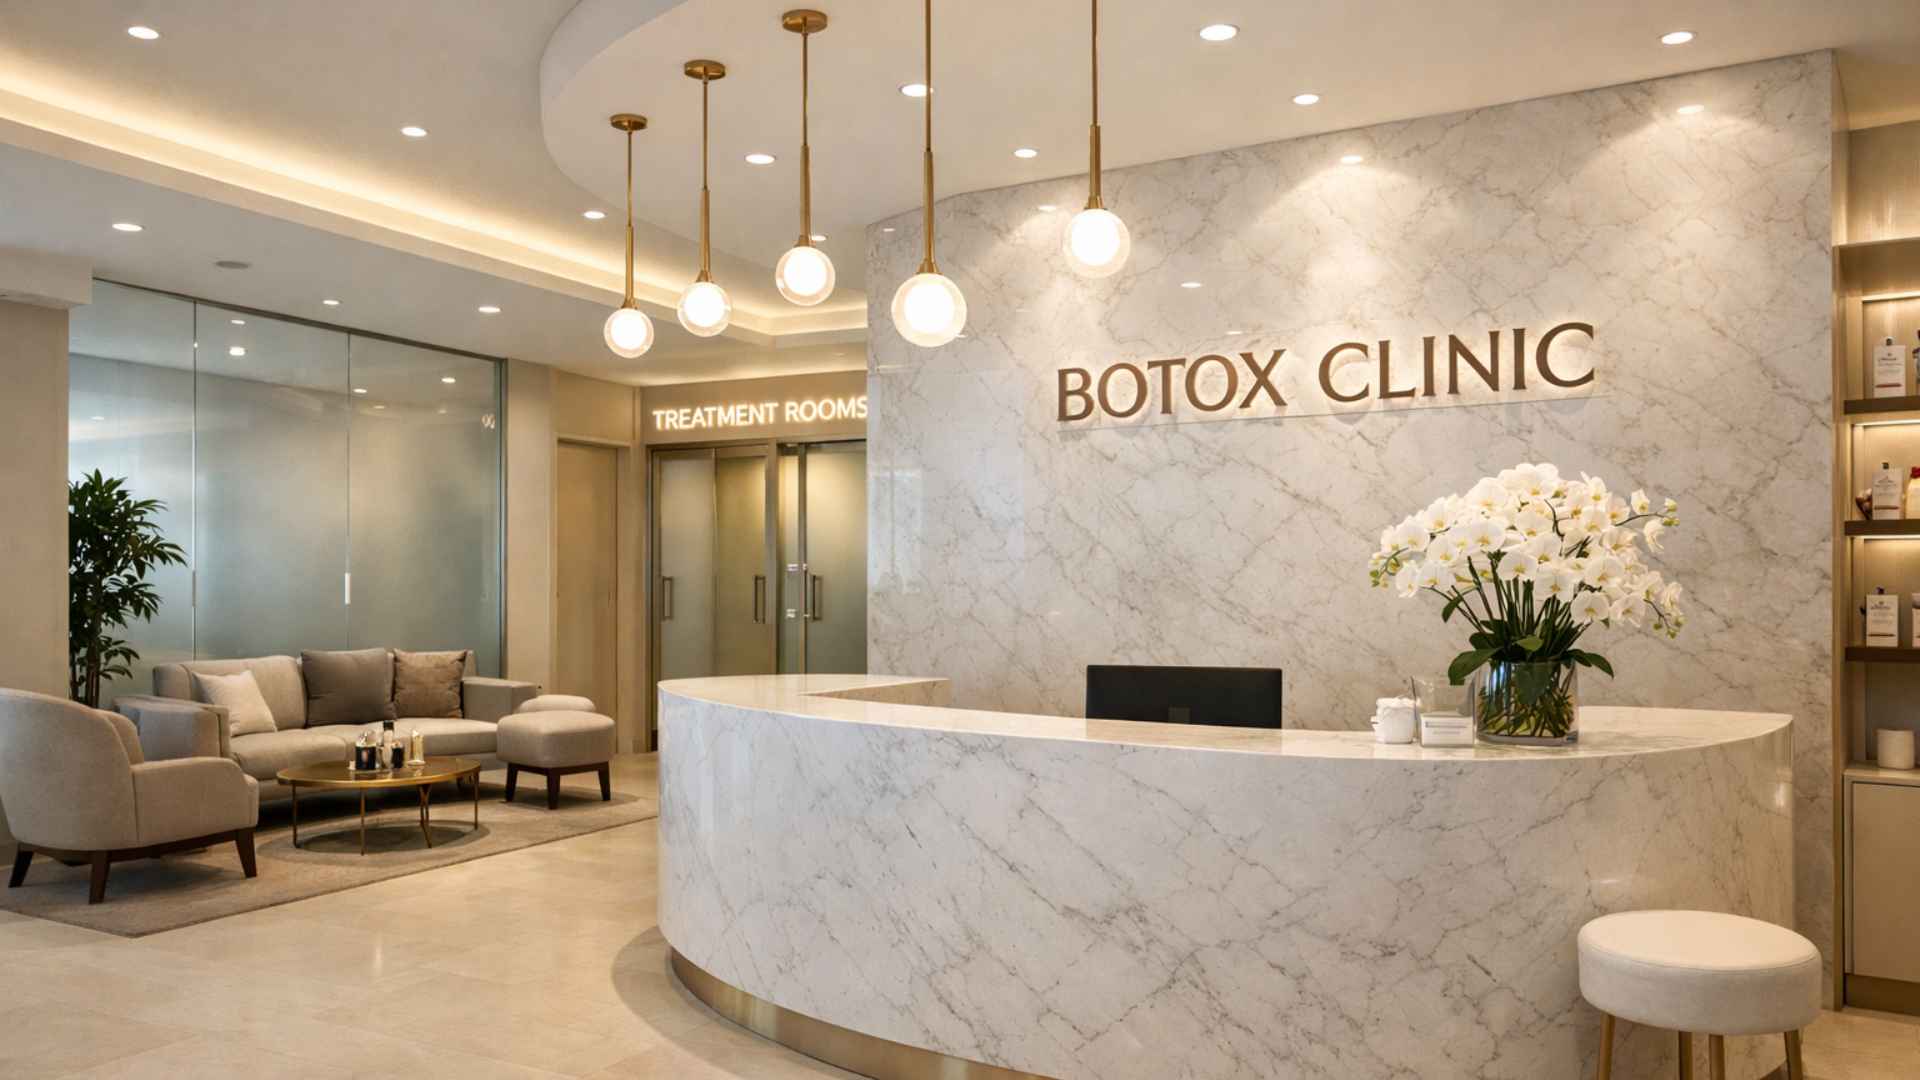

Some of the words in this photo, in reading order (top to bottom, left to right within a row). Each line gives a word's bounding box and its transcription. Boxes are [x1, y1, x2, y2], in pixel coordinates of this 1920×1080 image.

[1057, 348, 1288, 422] BOTOX
[1318, 322, 1596, 403] CLINIC
[652, 402, 779, 430] TREATMENT
[785, 395, 868, 423] ROOMS
